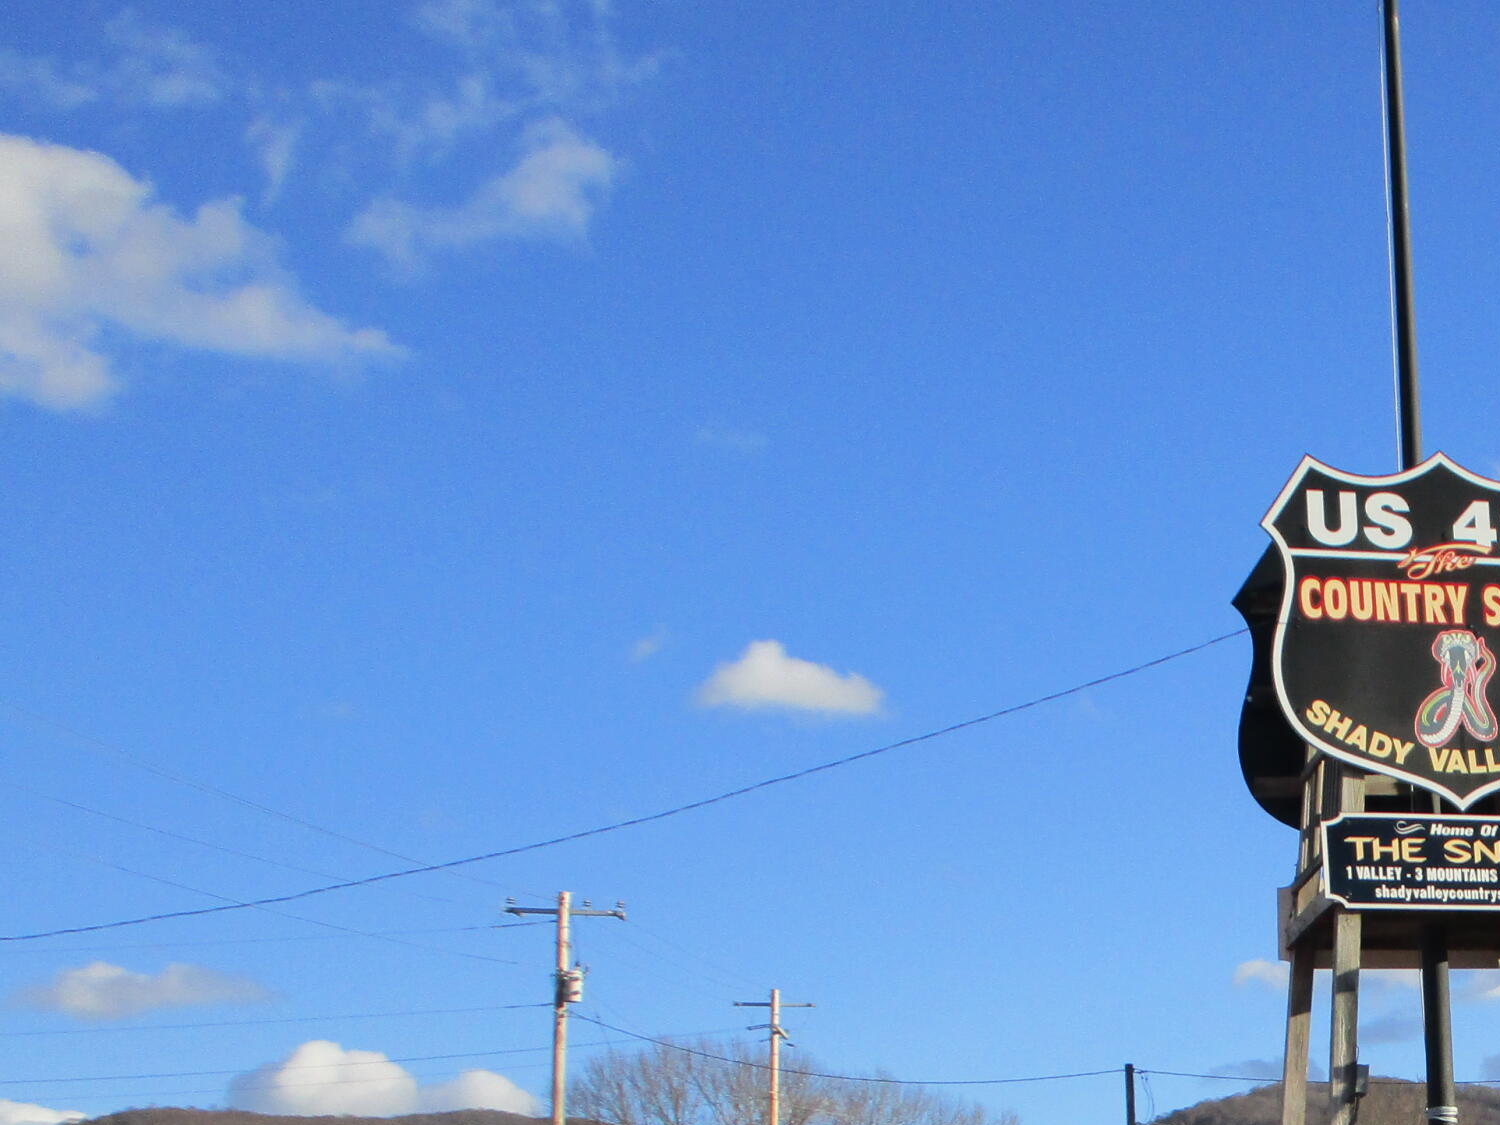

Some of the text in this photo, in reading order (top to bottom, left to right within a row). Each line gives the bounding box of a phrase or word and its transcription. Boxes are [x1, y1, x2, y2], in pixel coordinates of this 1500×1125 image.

[1305, 488, 1413, 550] US
[1397, 542, 1492, 581] The
[1300, 575, 1469, 624] COUNTRY
[1304, 698, 1416, 767] SHADY
[1343, 836, 1428, 863] THE
[1430, 823, 1499, 837] Home Of
[1346, 866, 1353, 880] 1
[1356, 866, 1403, 882] VALLEY
[1414, 867, 1424, 882] 3
[1426, 867, 1498, 883] MOUNTAINS
